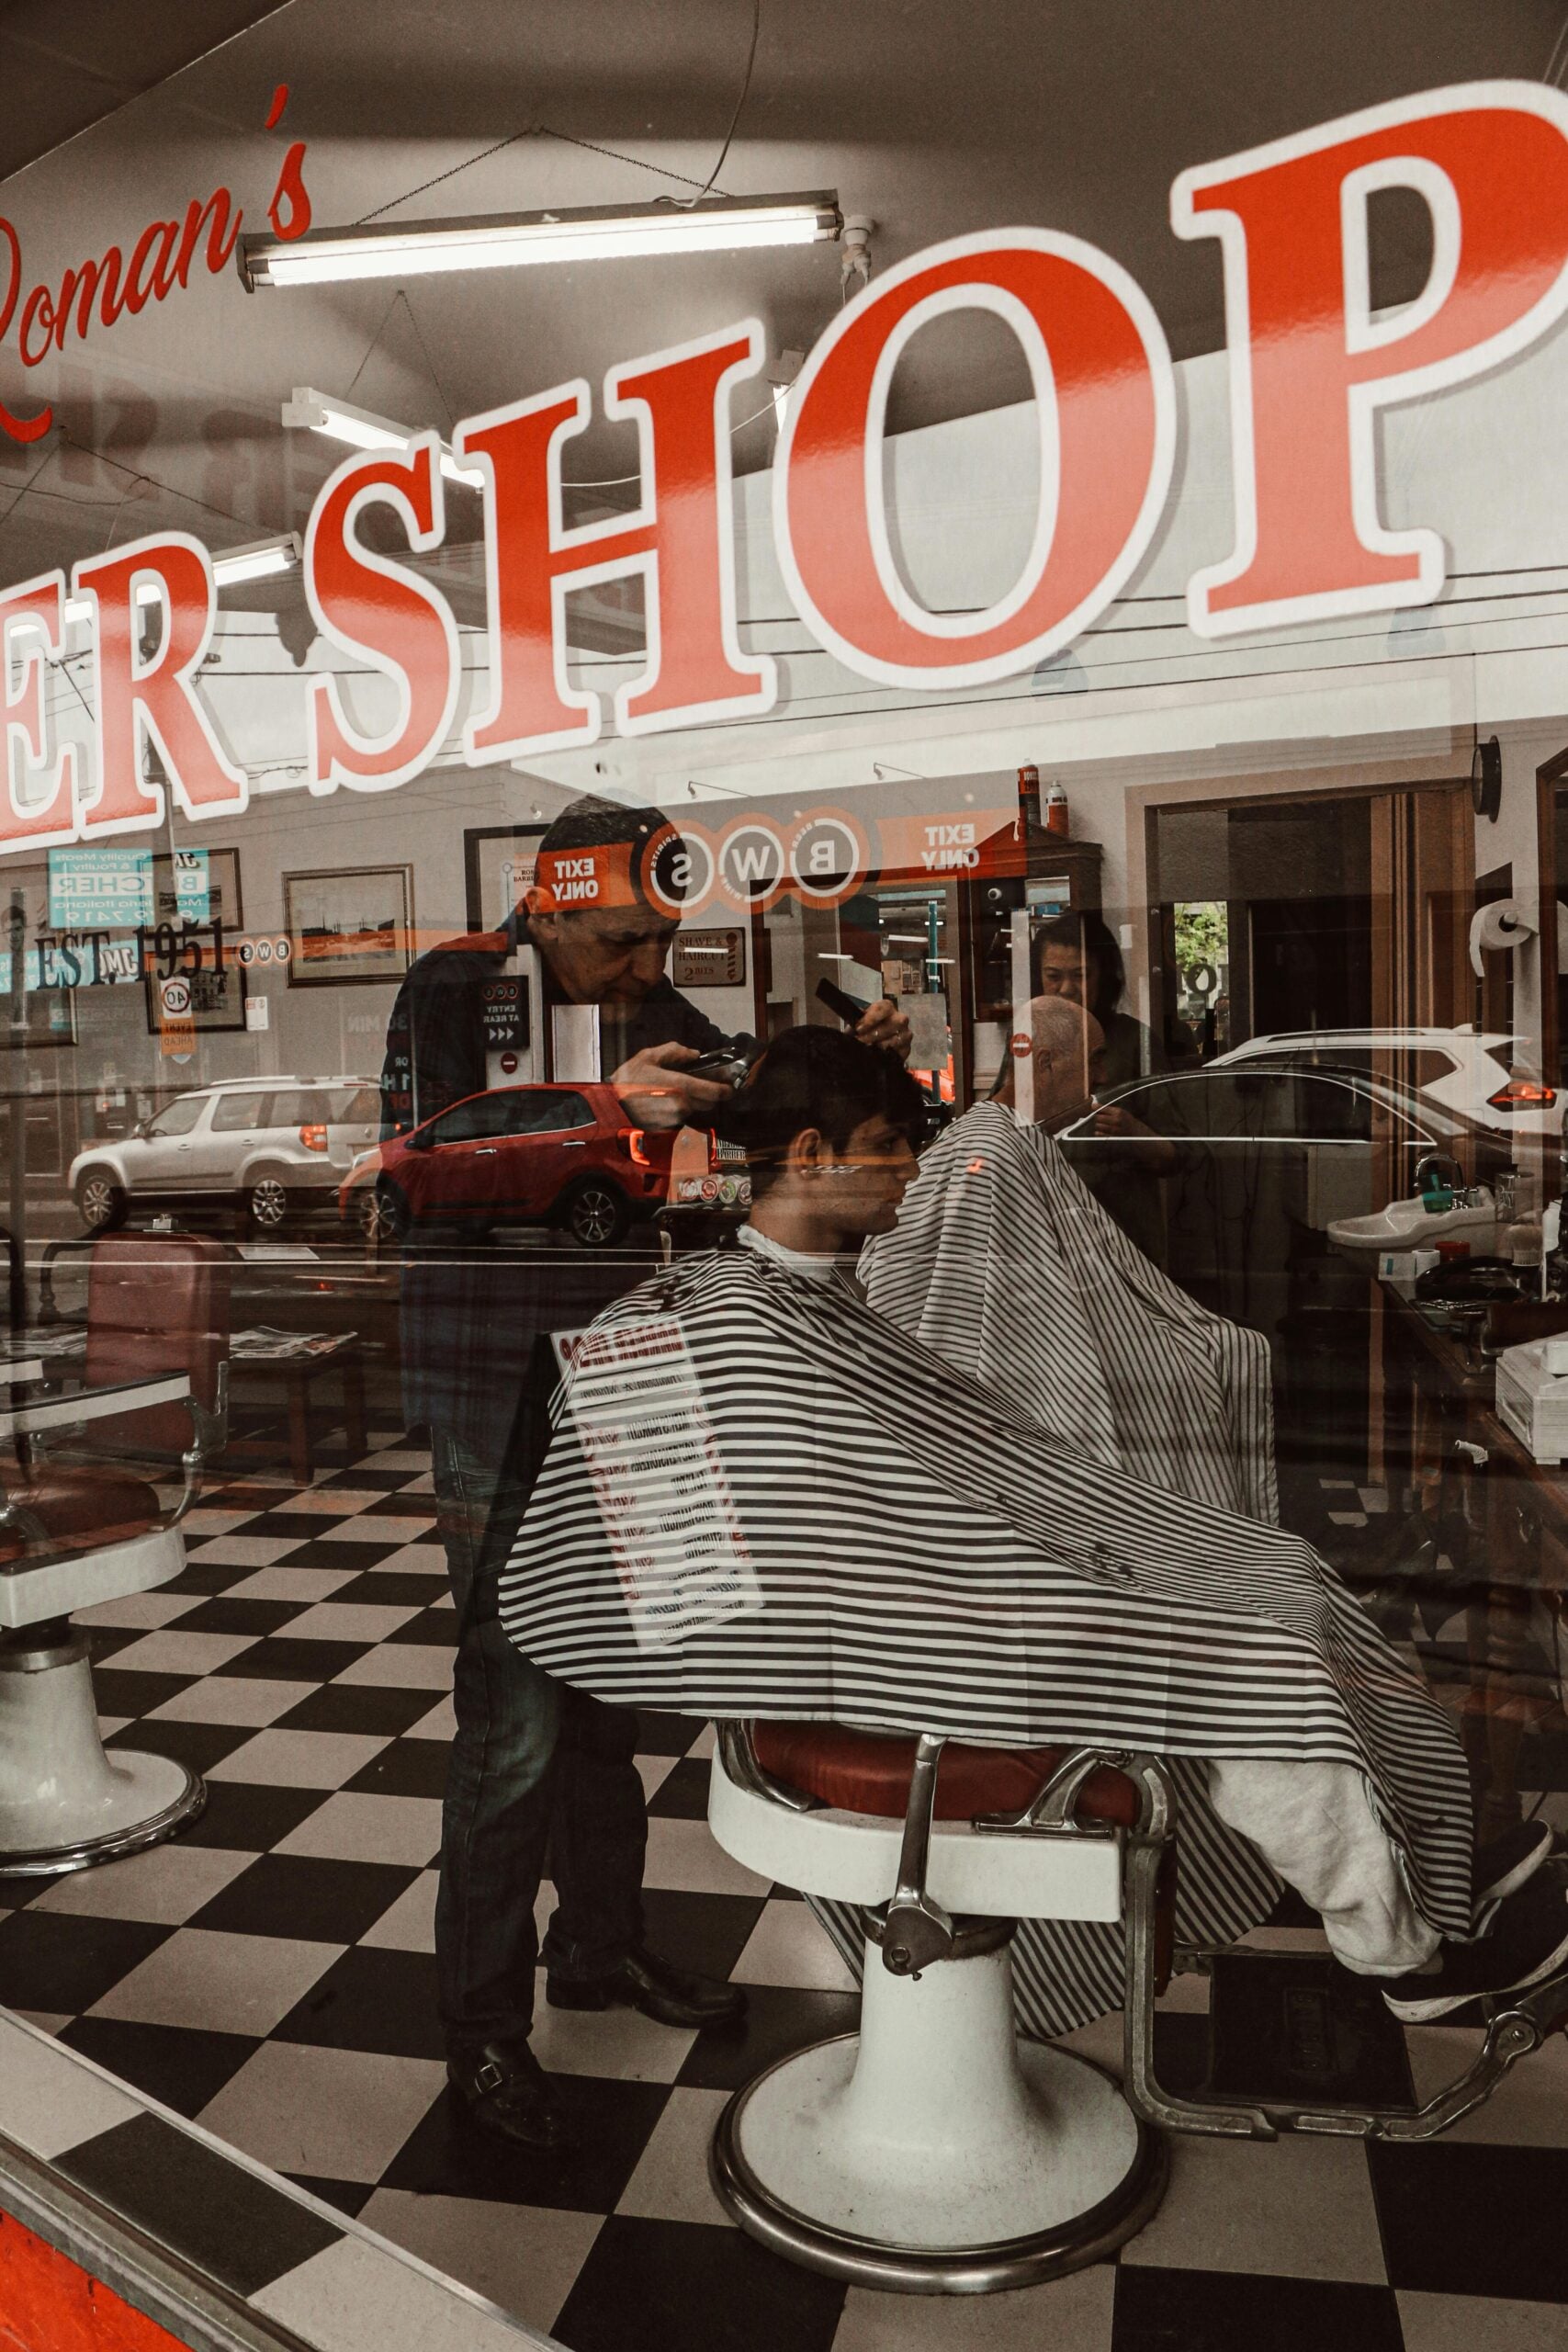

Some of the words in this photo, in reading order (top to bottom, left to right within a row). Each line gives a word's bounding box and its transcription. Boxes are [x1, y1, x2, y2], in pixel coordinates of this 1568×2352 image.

[302, 78, 1568, 797] SHOP
[678, 935, 713, 947] SHAVE
[715, 936, 724, 946] &
[34, 930, 118, 990] EST.
[133, 916, 229, 982] 1951
[678, 951, 726, 962] HAIRCUT
[683, 967, 694, 981] 2
